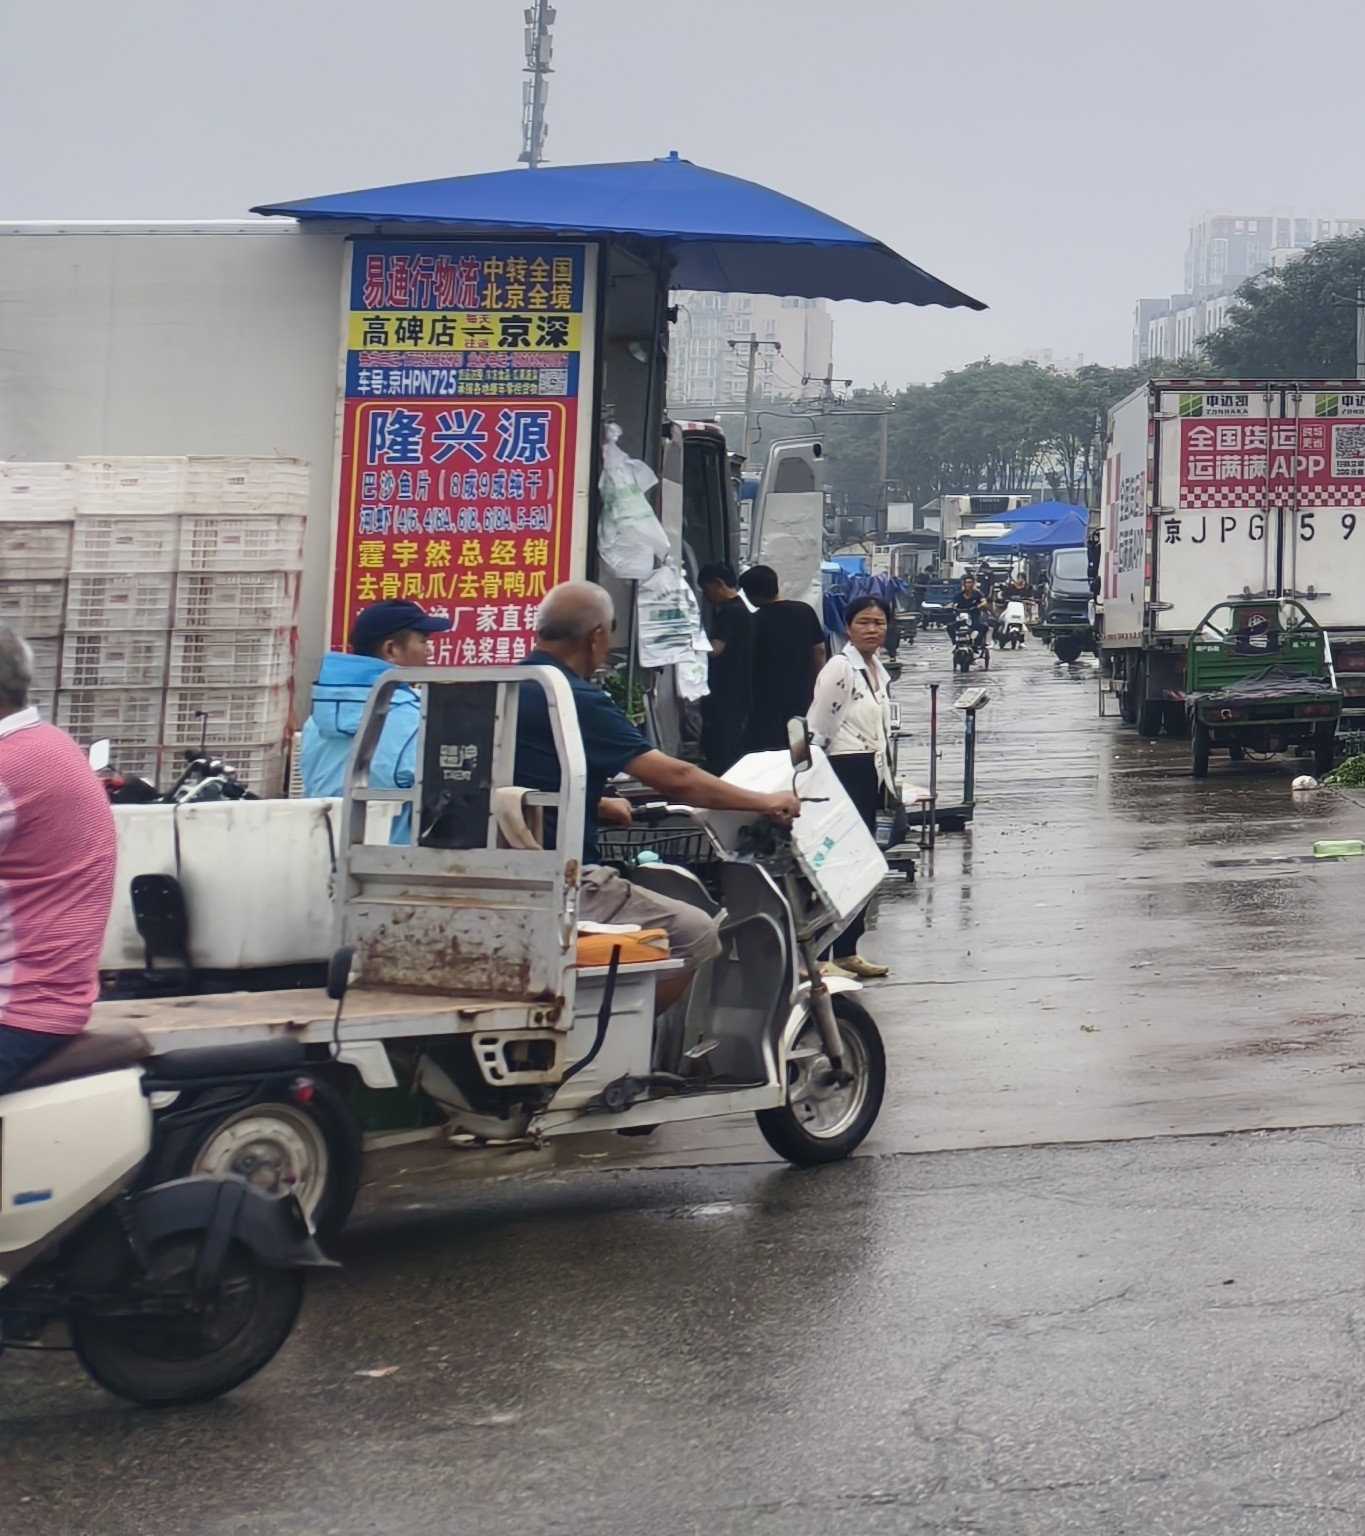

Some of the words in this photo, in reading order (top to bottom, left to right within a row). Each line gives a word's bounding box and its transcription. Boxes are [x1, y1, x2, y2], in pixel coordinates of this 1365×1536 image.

[362, 254, 480, 309] 易通行物流
[484, 257, 573, 283] 中转全国
[481, 283, 573, 310] 北京全境
[362, 315, 458, 348] 高碑店
[498, 315, 570, 348] 京深
[367, 408, 552, 465] 隆兴源
[1188, 425, 1296, 450] 全国货运
[1188, 454, 1325, 481] 运满满APP
[356, 571, 548, 601] 去骨凤爪/去骨鸭爪
